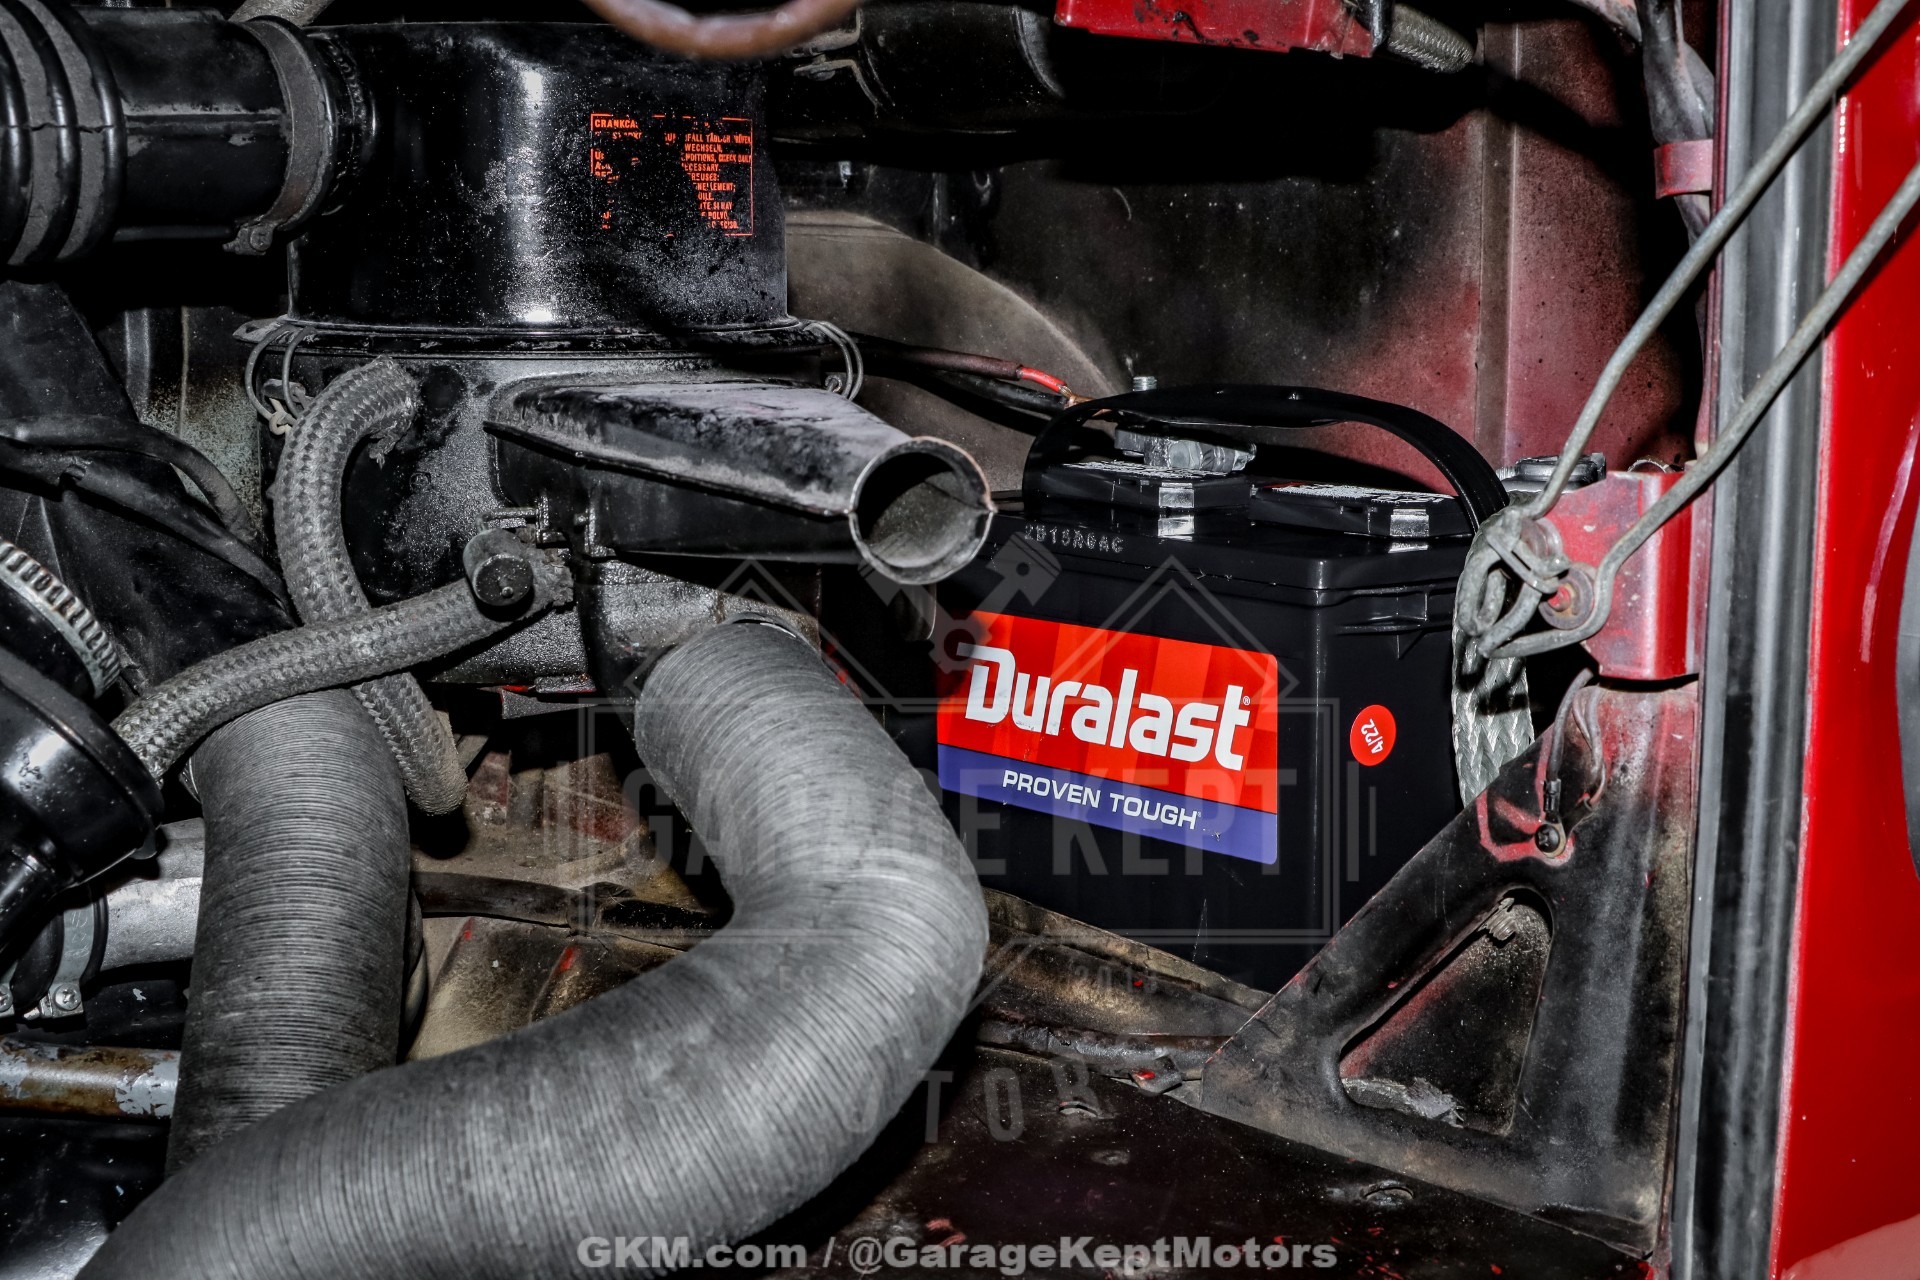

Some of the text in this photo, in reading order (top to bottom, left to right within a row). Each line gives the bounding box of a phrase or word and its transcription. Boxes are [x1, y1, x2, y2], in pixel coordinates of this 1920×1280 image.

[595, 120, 638, 129] CRANKCA
[719, 154, 737, 163] CHECK
[957, 641, 1251, 772] Duralast
[1361, 718, 1384, 754] 4/22
[1002, 769, 1198, 830] PROVEN TOUGH
